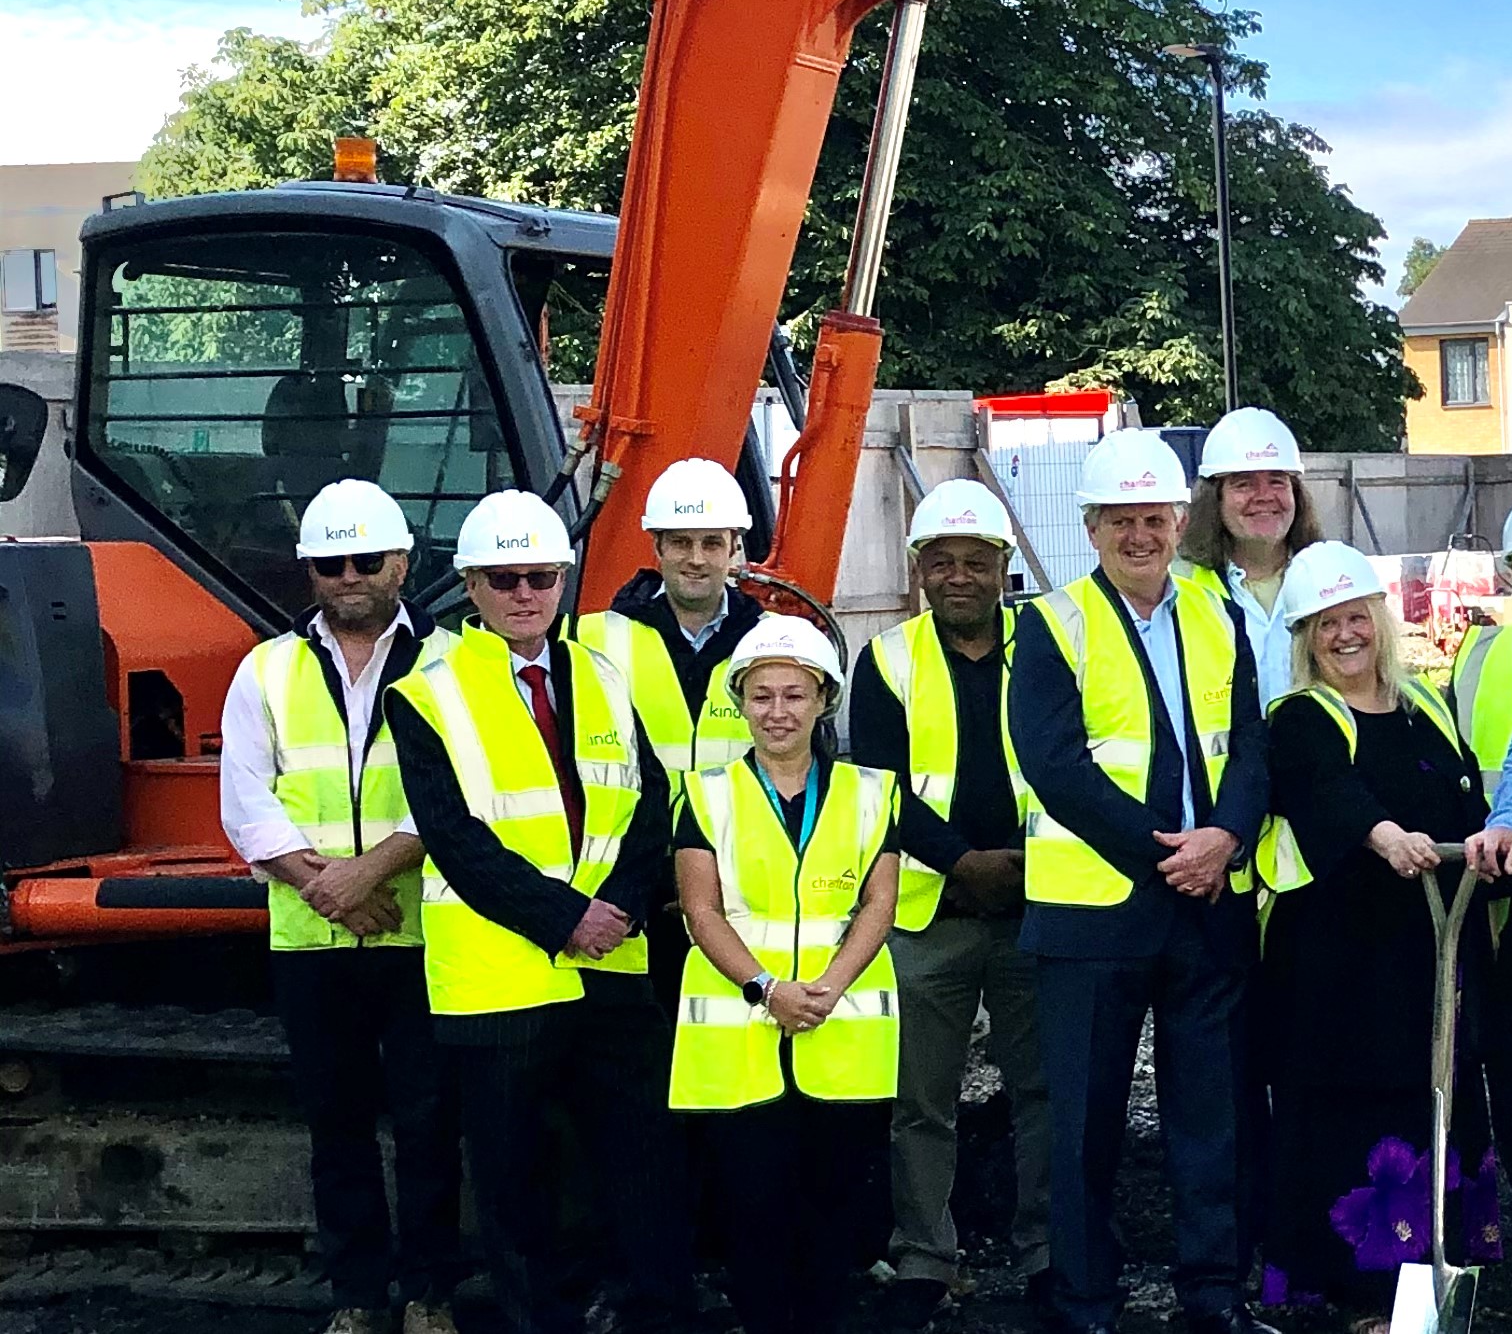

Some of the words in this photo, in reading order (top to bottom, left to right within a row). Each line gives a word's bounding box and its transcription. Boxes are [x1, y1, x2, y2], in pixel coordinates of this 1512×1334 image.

[674, 499, 704, 515] kind
[325, 523, 357, 541] kind
[496, 532, 530, 550] kind
